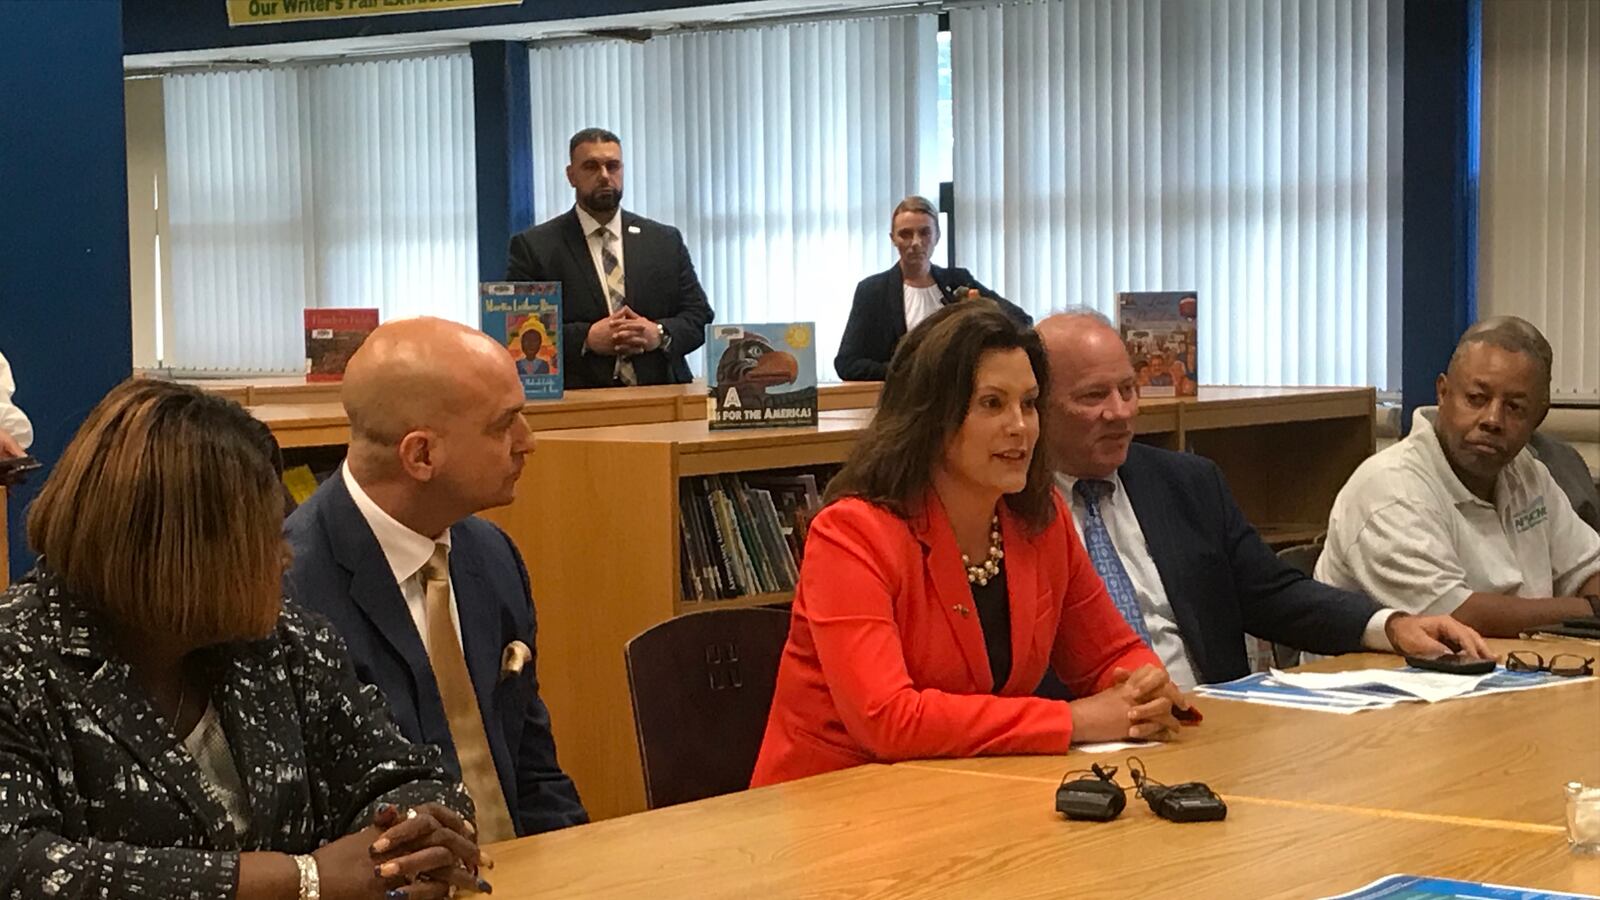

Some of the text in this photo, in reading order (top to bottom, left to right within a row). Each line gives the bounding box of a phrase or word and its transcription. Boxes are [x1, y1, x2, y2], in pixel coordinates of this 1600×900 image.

[249, 0, 278, 16] Our
[513, 297, 539, 312] Luther
[723, 387, 742, 408] A
[723, 411, 742, 421] FOR
[744, 409, 762, 420] THE
[764, 407, 812, 419] AMERICAS
